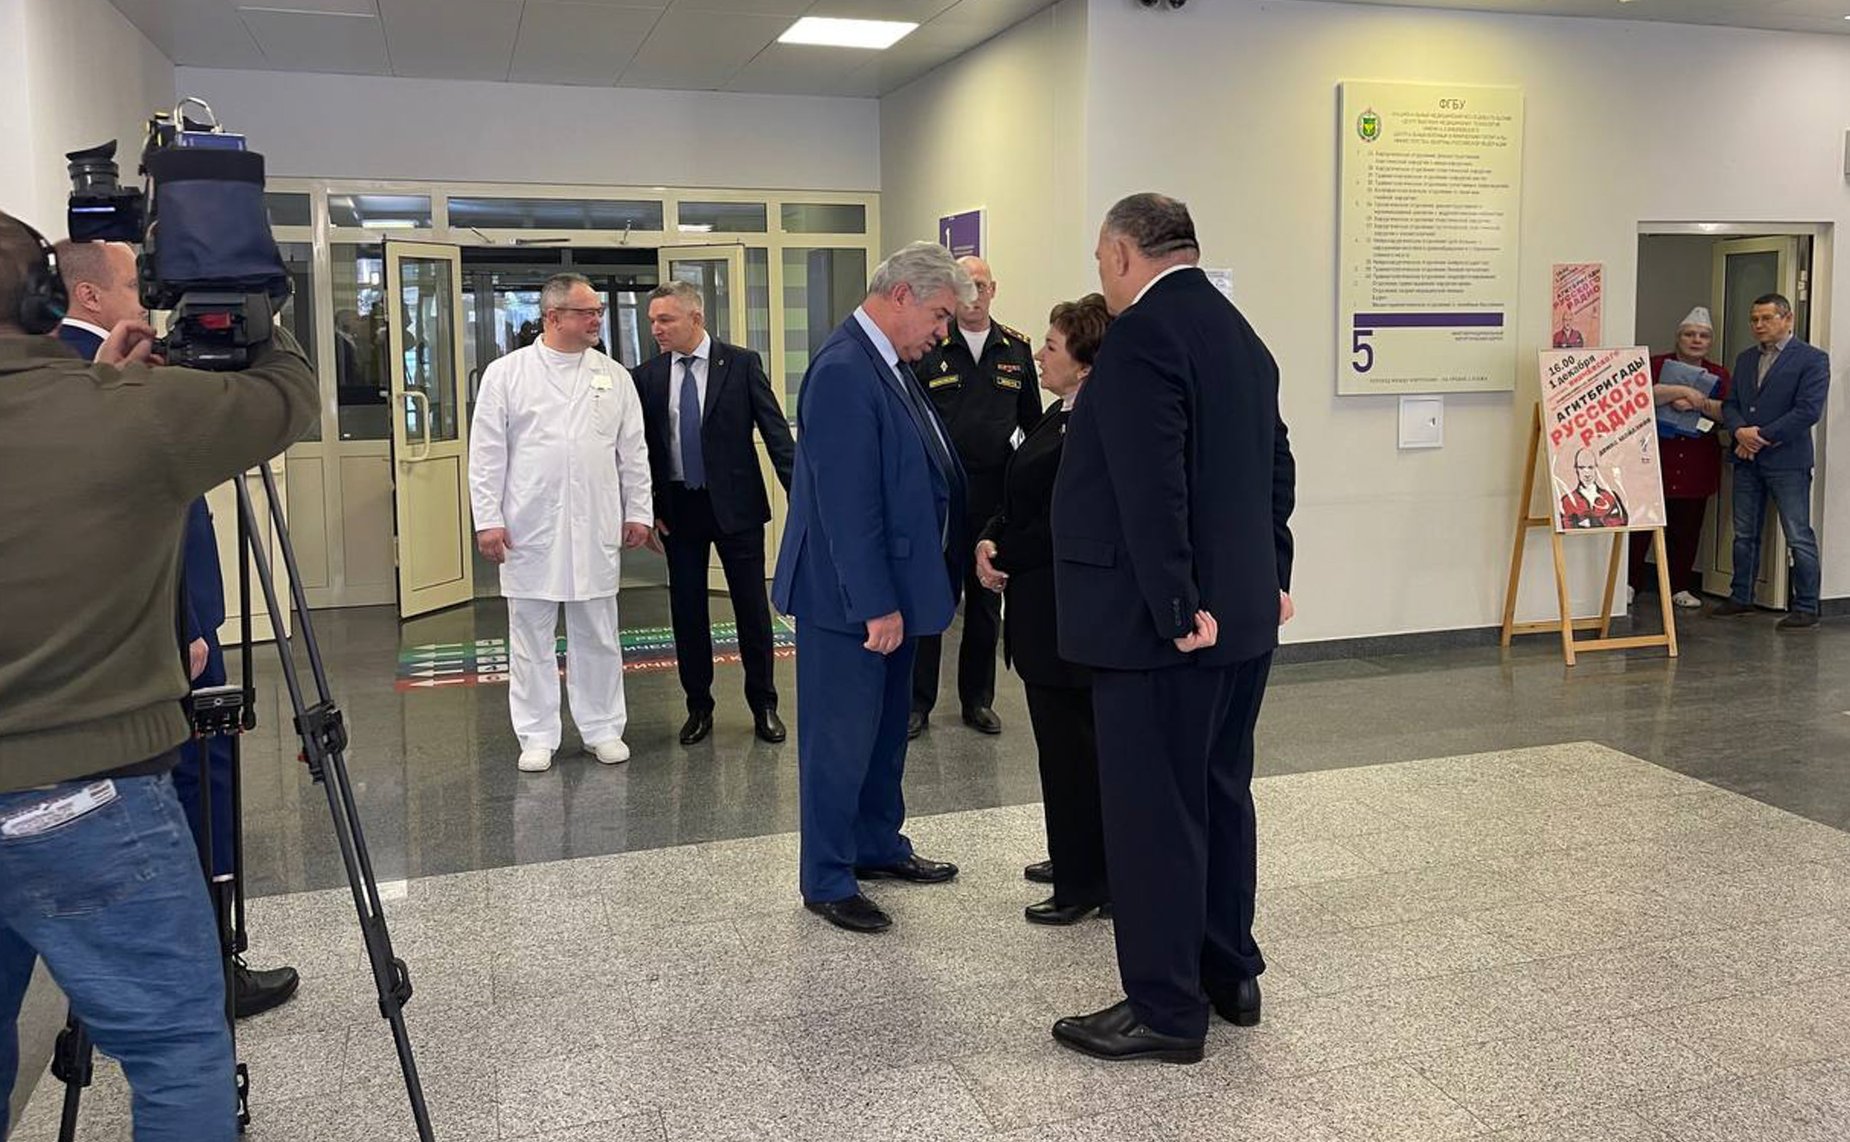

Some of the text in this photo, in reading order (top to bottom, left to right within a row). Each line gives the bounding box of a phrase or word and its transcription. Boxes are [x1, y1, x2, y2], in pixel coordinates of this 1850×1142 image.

[1439, 99, 1466, 110] ФГБУ
[1352, 329, 1374, 373] 5
[1548, 355, 1575, 377] 16.00
[1557, 355, 1596, 385] декабря
[1551, 372, 1648, 446] РУССКОГО
[1556, 356, 1645, 423] АГИТБРИГАДЫ
[1580, 392, 1650, 447] РАДИО
